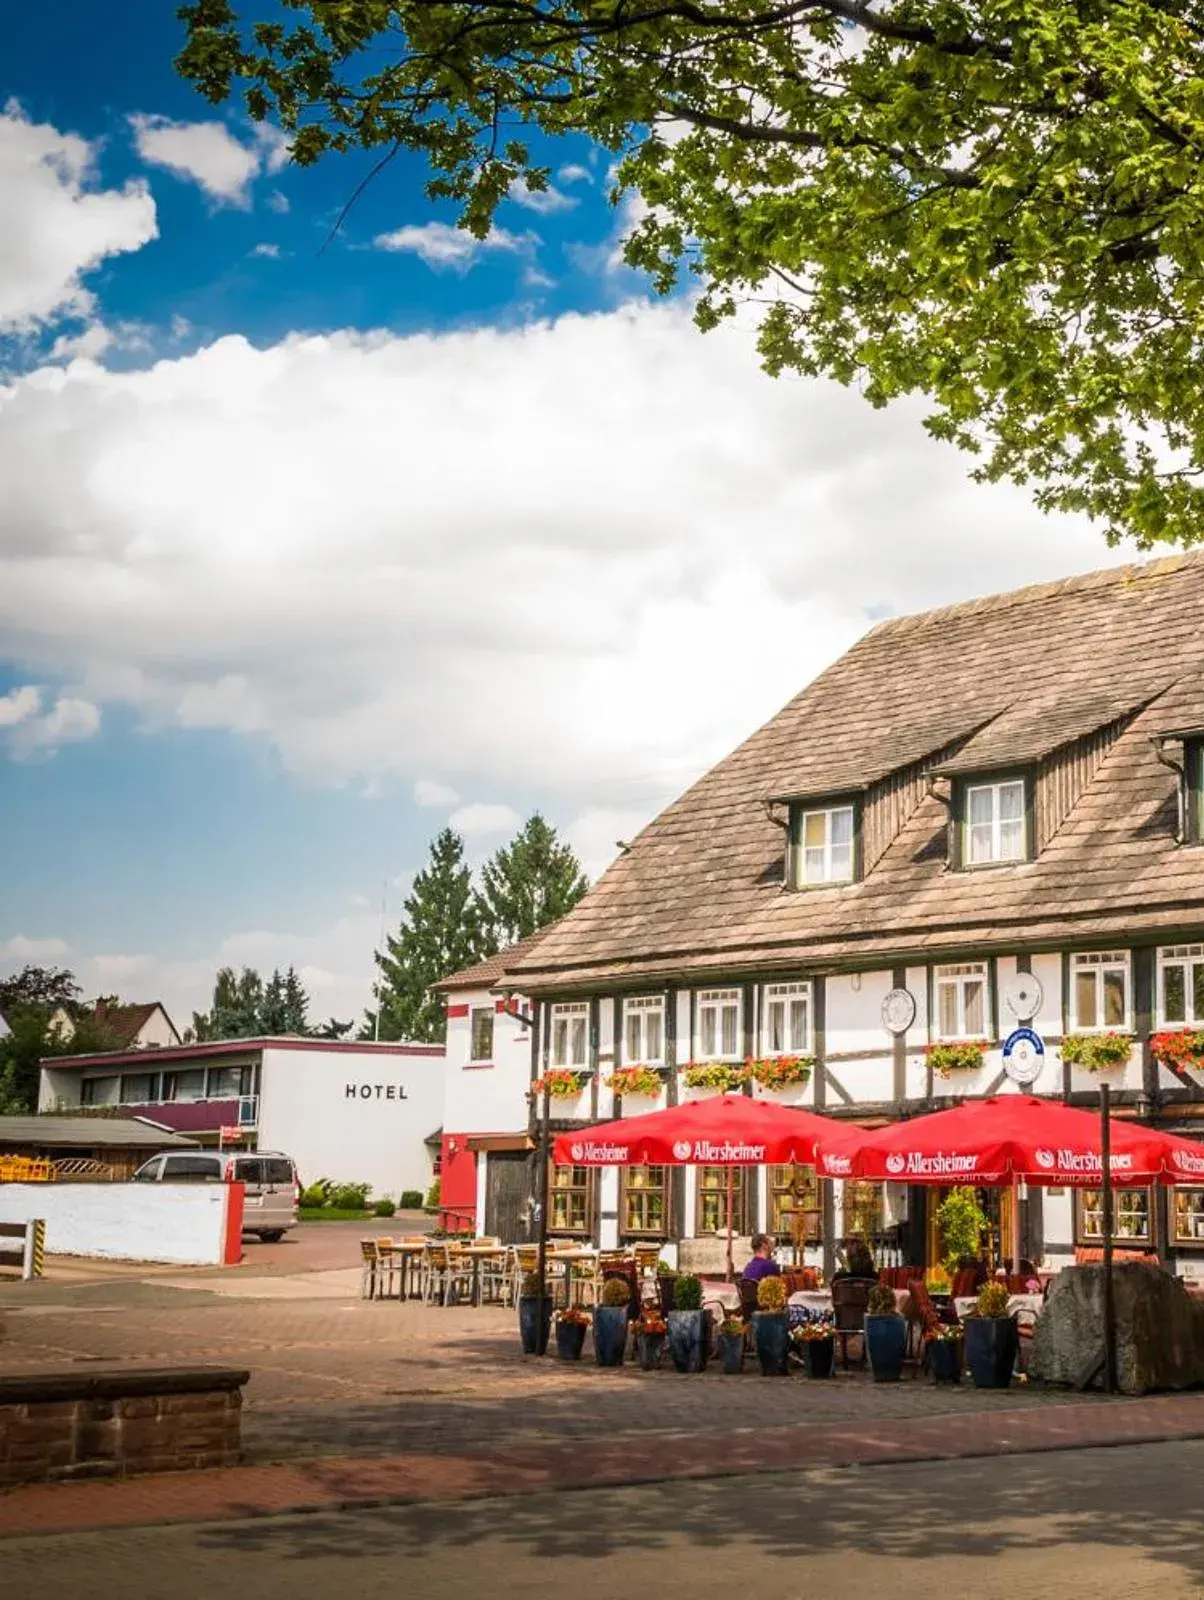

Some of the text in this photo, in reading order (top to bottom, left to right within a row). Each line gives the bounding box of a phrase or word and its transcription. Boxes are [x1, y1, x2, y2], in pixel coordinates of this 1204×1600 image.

[345, 1084, 408, 1100] HOTEL
[693, 1141, 766, 1161] Allersheimer
[1057, 1150, 1133, 1170] Allershemer
[906, 1151, 979, 1173] Allersheimer
